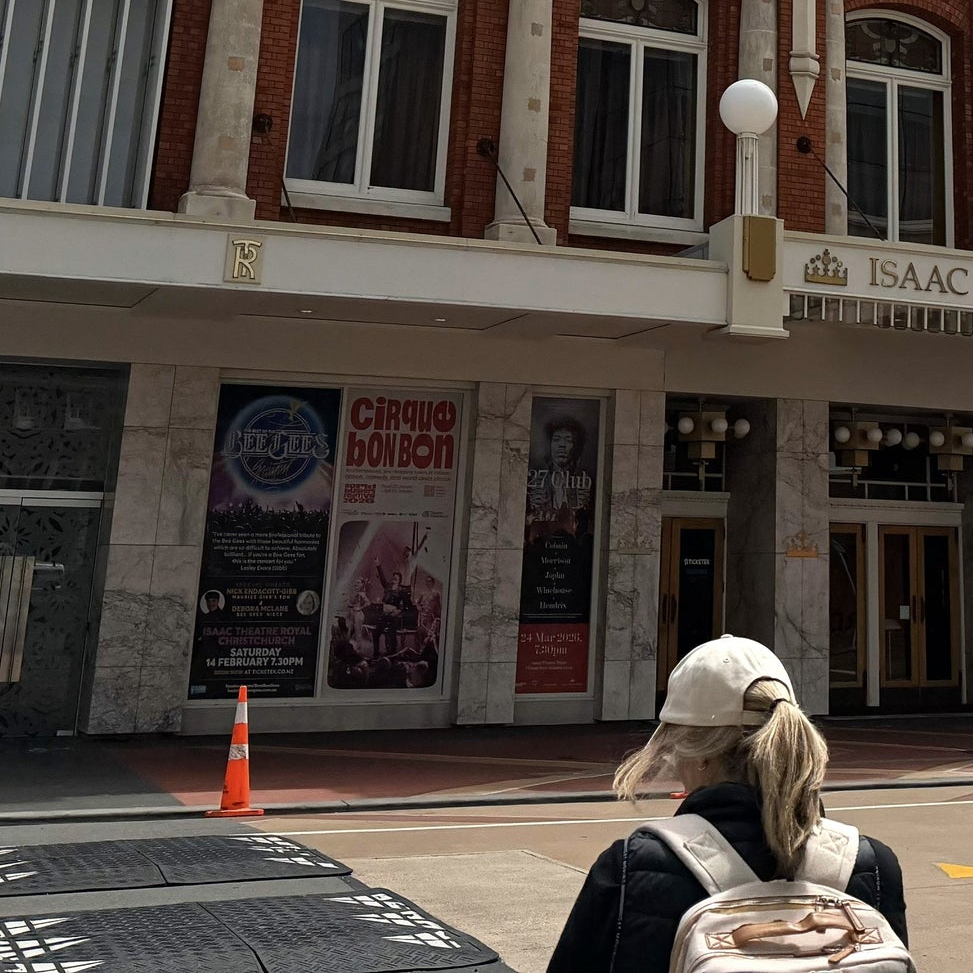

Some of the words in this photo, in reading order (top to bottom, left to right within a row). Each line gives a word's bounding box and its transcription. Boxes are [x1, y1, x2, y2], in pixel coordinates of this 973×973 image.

[869, 258, 968, 295] ISAAC
[528, 469, 549, 488] 27
[552, 470, 592, 489] Club
[544, 571, 565, 580] Joplin
[536, 586, 573, 594] Winehouse
[539, 601, 568, 610] Hendrix
[203, 627, 233, 636] ISAAC
[235, 627, 279, 636] THEATRE
[280, 627, 312, 636] ROYAL
[218, 636, 295, 645] CHRISTCHURCH
[520, 633, 533, 643] 24
[536, 633, 554, 643] Mar
[230, 647, 282, 657] SATURDAY
[206, 657, 216, 667] 14
[218, 657, 268, 667] FEBRUARY
[271, 657, 303, 667] 7.30PM
